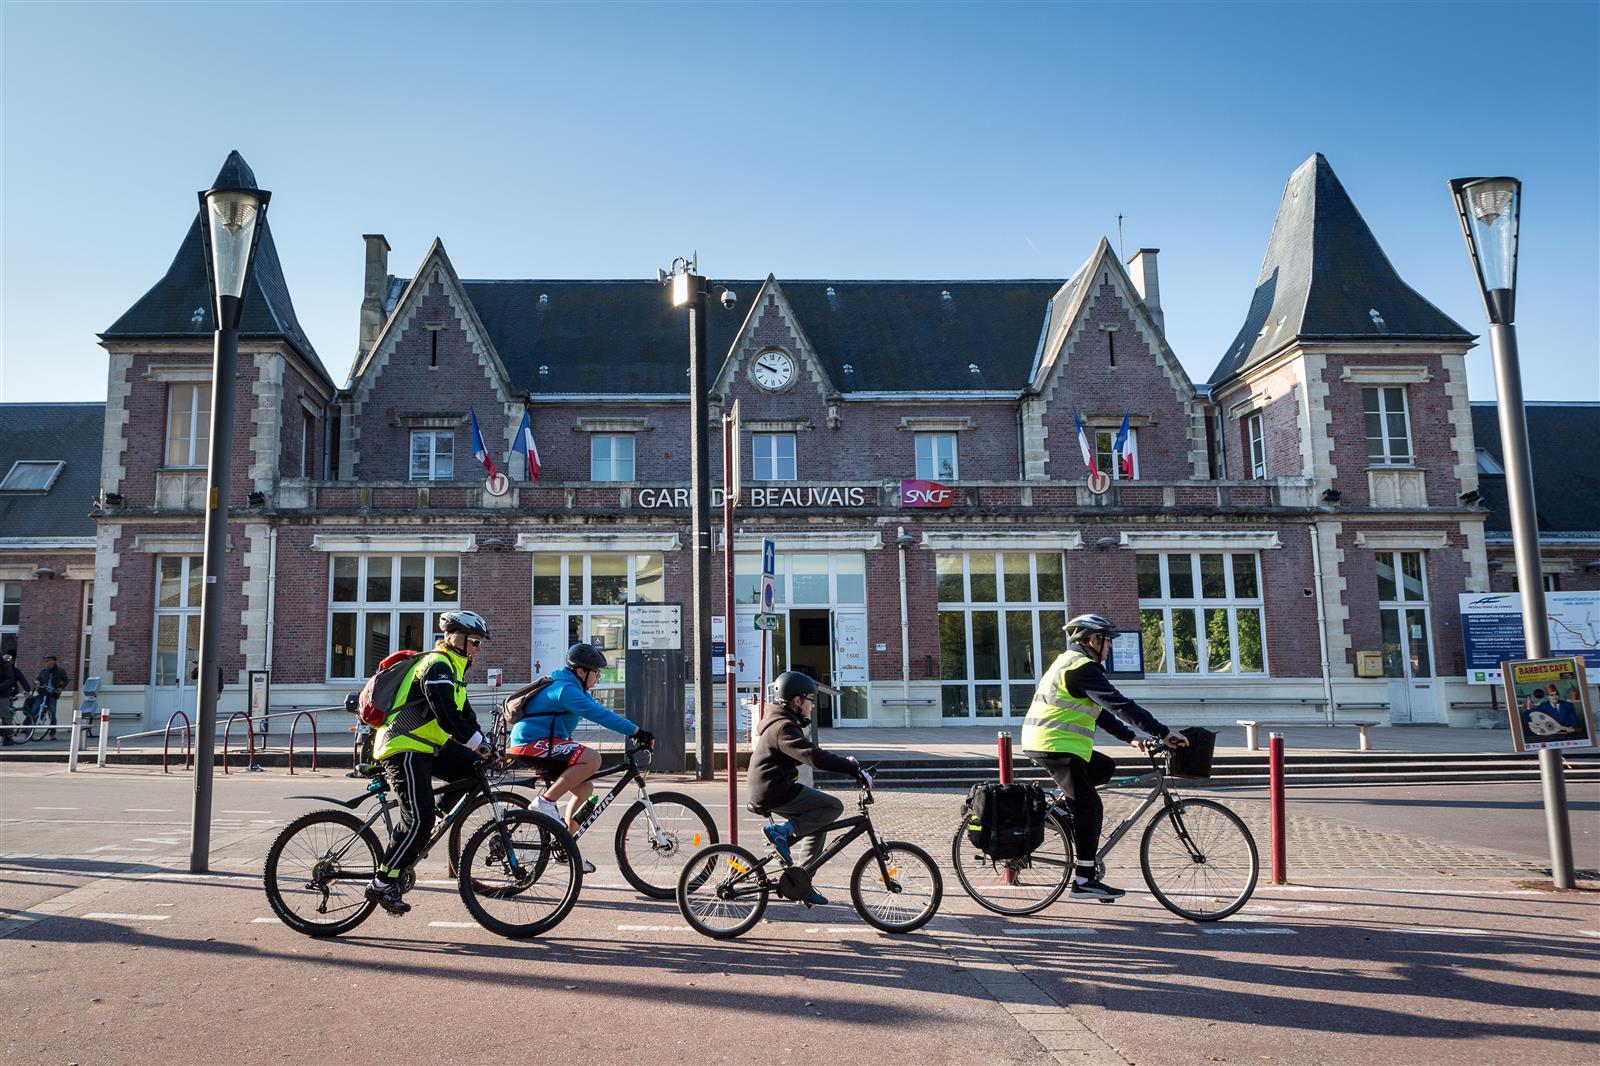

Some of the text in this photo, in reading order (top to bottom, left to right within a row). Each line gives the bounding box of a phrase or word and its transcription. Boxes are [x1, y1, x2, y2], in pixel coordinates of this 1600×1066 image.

[639, 488, 693, 508] GAR
[751, 488, 865, 508] BEAUVAIS
[903, 489, 950, 504] SNCF
